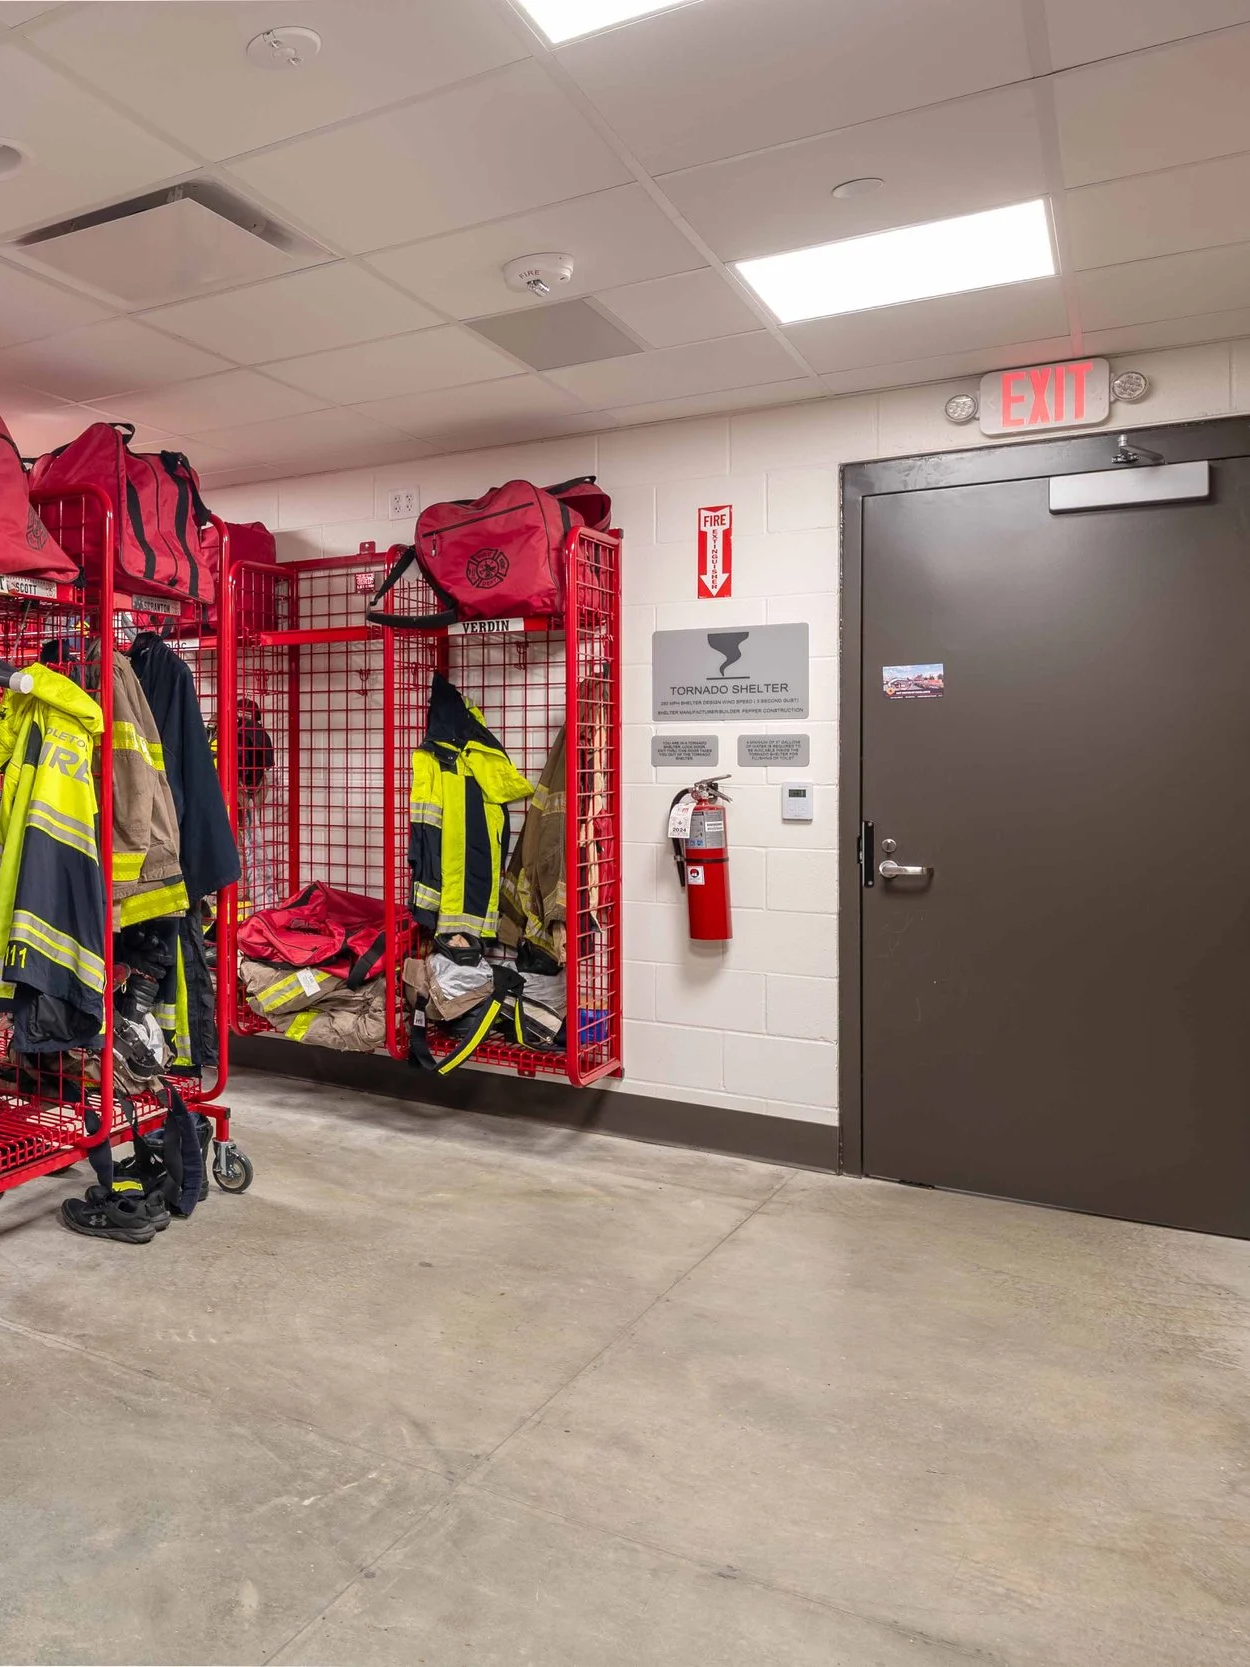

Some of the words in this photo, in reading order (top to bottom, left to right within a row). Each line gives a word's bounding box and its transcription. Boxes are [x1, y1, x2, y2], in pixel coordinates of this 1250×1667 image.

[518, 269, 541, 280] FIRE
[1001, 361, 1093, 428] EXIT
[703, 514, 727, 527] FIRE
[15, 582, 37, 595] SCOTT
[462, 620, 510, 634] VERDIN
[670, 685, 729, 696] TORNADO
[732, 683, 789, 694] SHELTER
